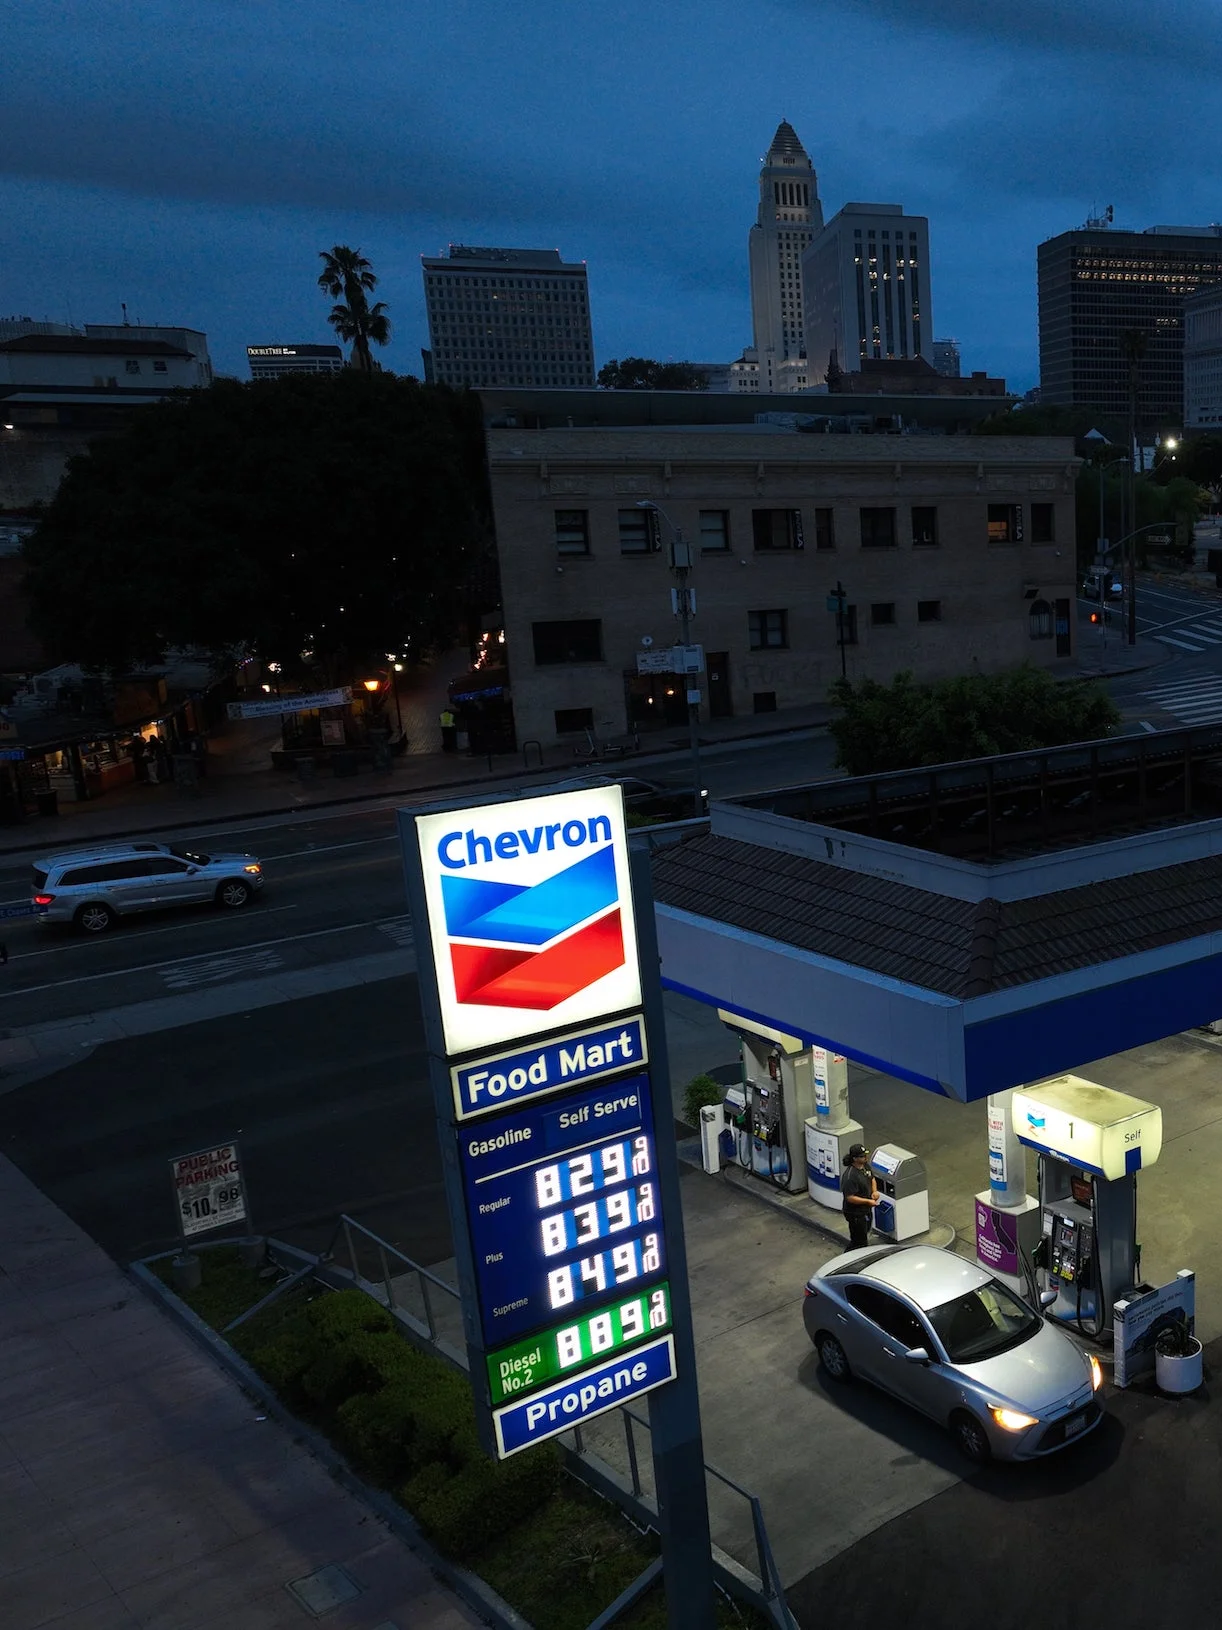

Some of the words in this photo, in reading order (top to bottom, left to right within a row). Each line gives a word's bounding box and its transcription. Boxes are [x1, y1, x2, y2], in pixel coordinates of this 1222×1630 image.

[437, 815, 612, 869] Chevron
[467, 1054, 547, 1103] Food
[559, 1030, 633, 1077] Mart
[468, 1126, 532, 1157] Gasoline
[559, 1105, 590, 1129] Self
[594, 1093, 638, 1118] Serve
[1068, 1121, 1075, 1139] 1
[1124, 1128, 1142, 1143] Self
[175, 1160, 239, 1188] PARKING
[179, 1148, 231, 1173] PUBLIC
[479, 1195, 512, 1214] Regular
[535, 1143, 627, 1209] 829
[485, 1252, 503, 1265] Plus
[540, 1189, 632, 1257] 839
[493, 1296, 529, 1318] Supreme
[547, 1241, 638, 1310] 849
[500, 1347, 541, 1378] Diesel
[556, 1299, 644, 1369] 889
[502, 1370, 533, 1395] No.2
[526, 1360, 648, 1431] Propane
